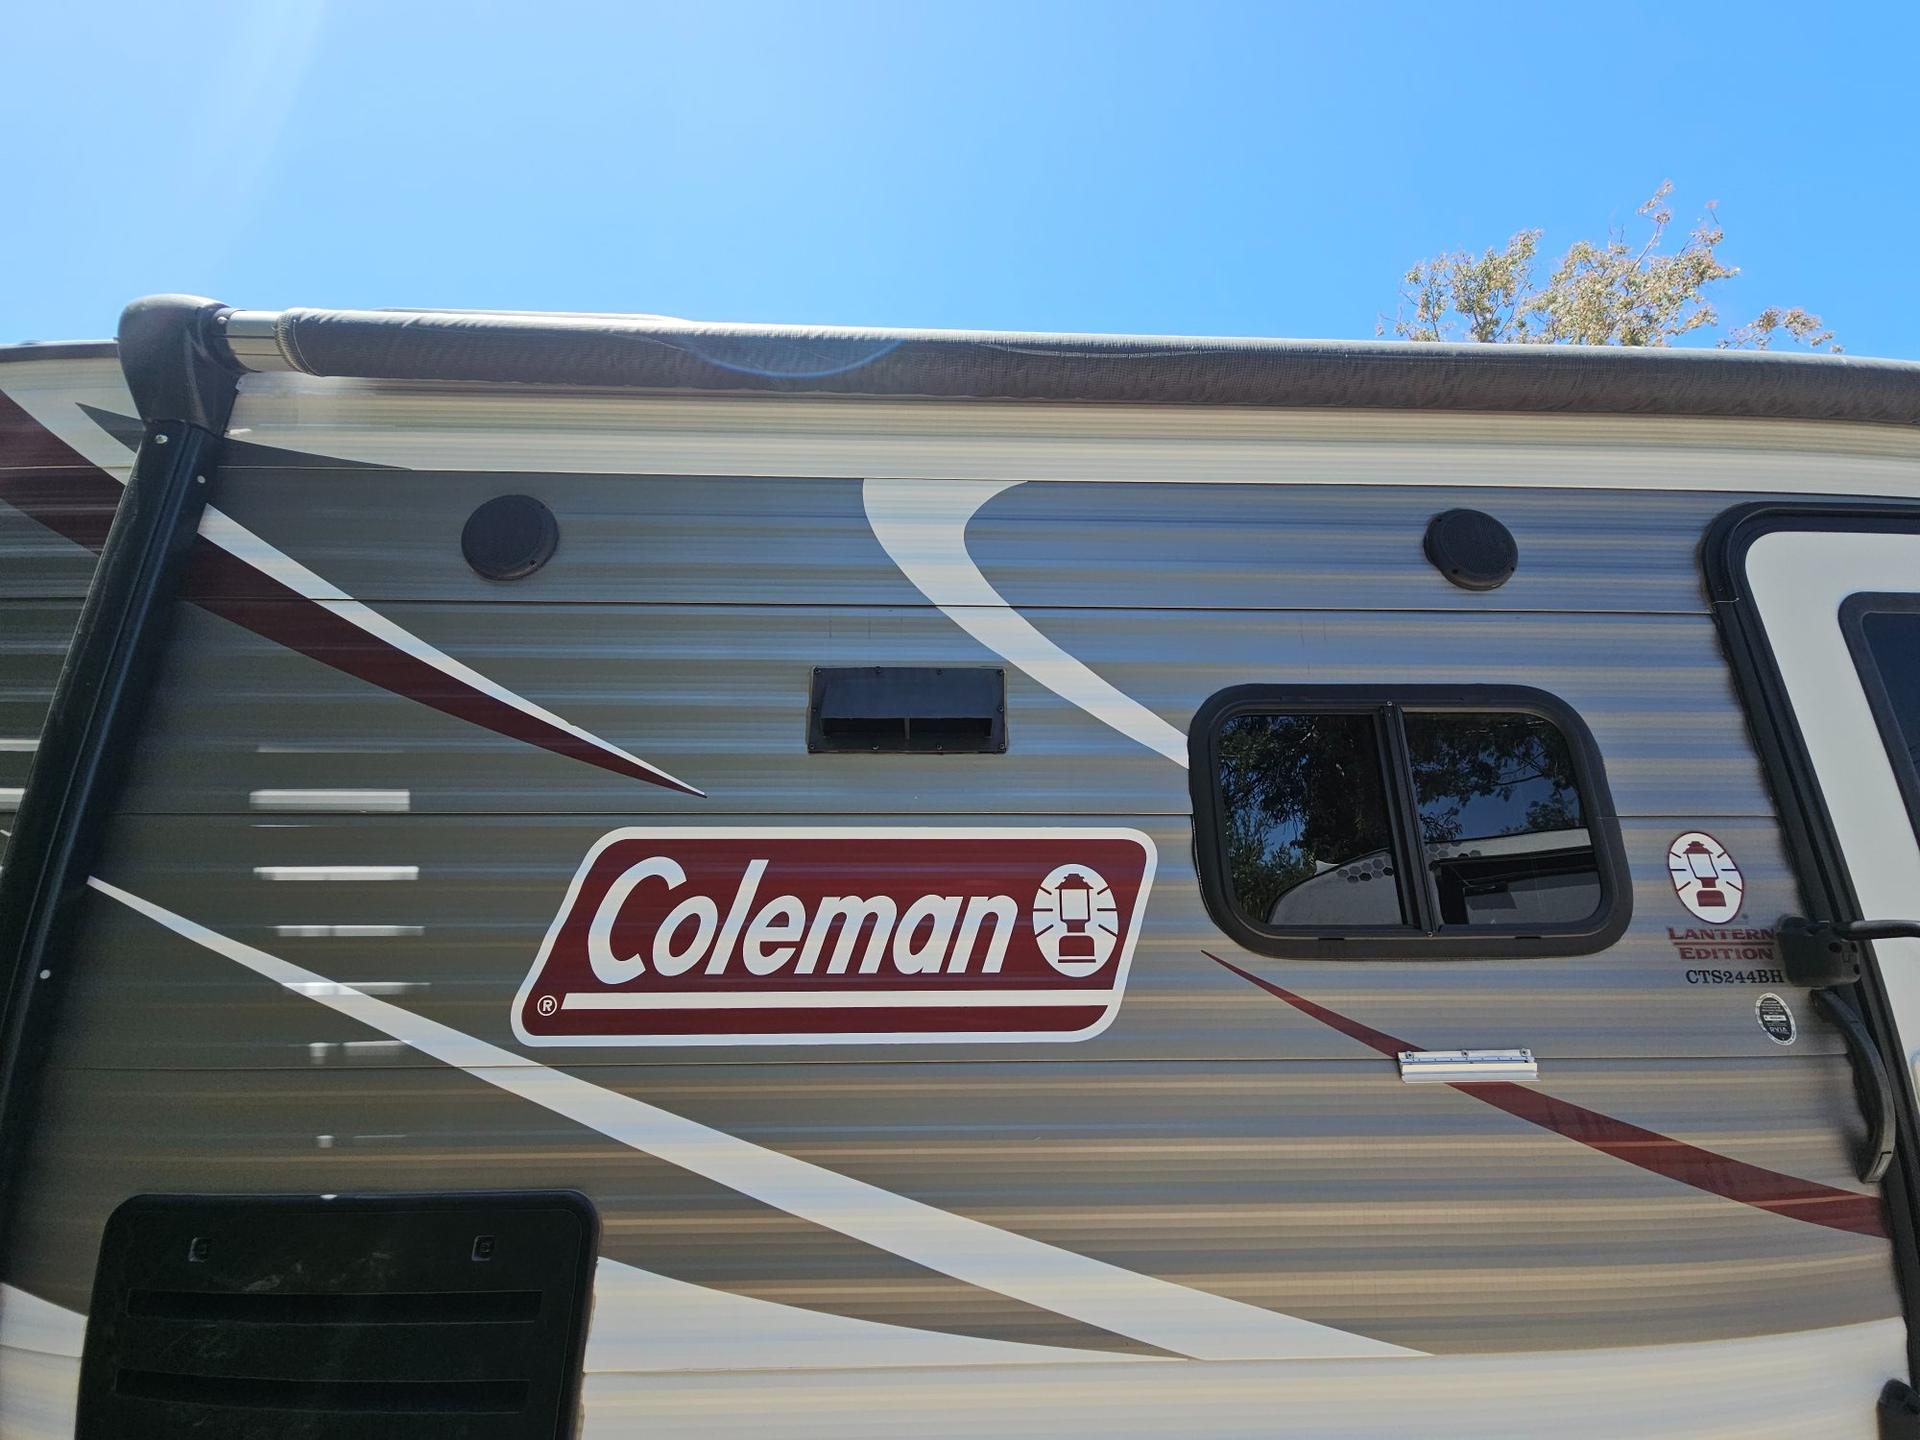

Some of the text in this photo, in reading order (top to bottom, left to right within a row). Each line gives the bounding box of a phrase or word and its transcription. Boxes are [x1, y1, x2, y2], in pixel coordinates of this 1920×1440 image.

[587, 856, 1019, 985] Coleman
[1667, 926, 1777, 940] LANTERN
[1679, 947, 1775, 960] EDITION
[1685, 969, 1785, 984] CTS244BH
